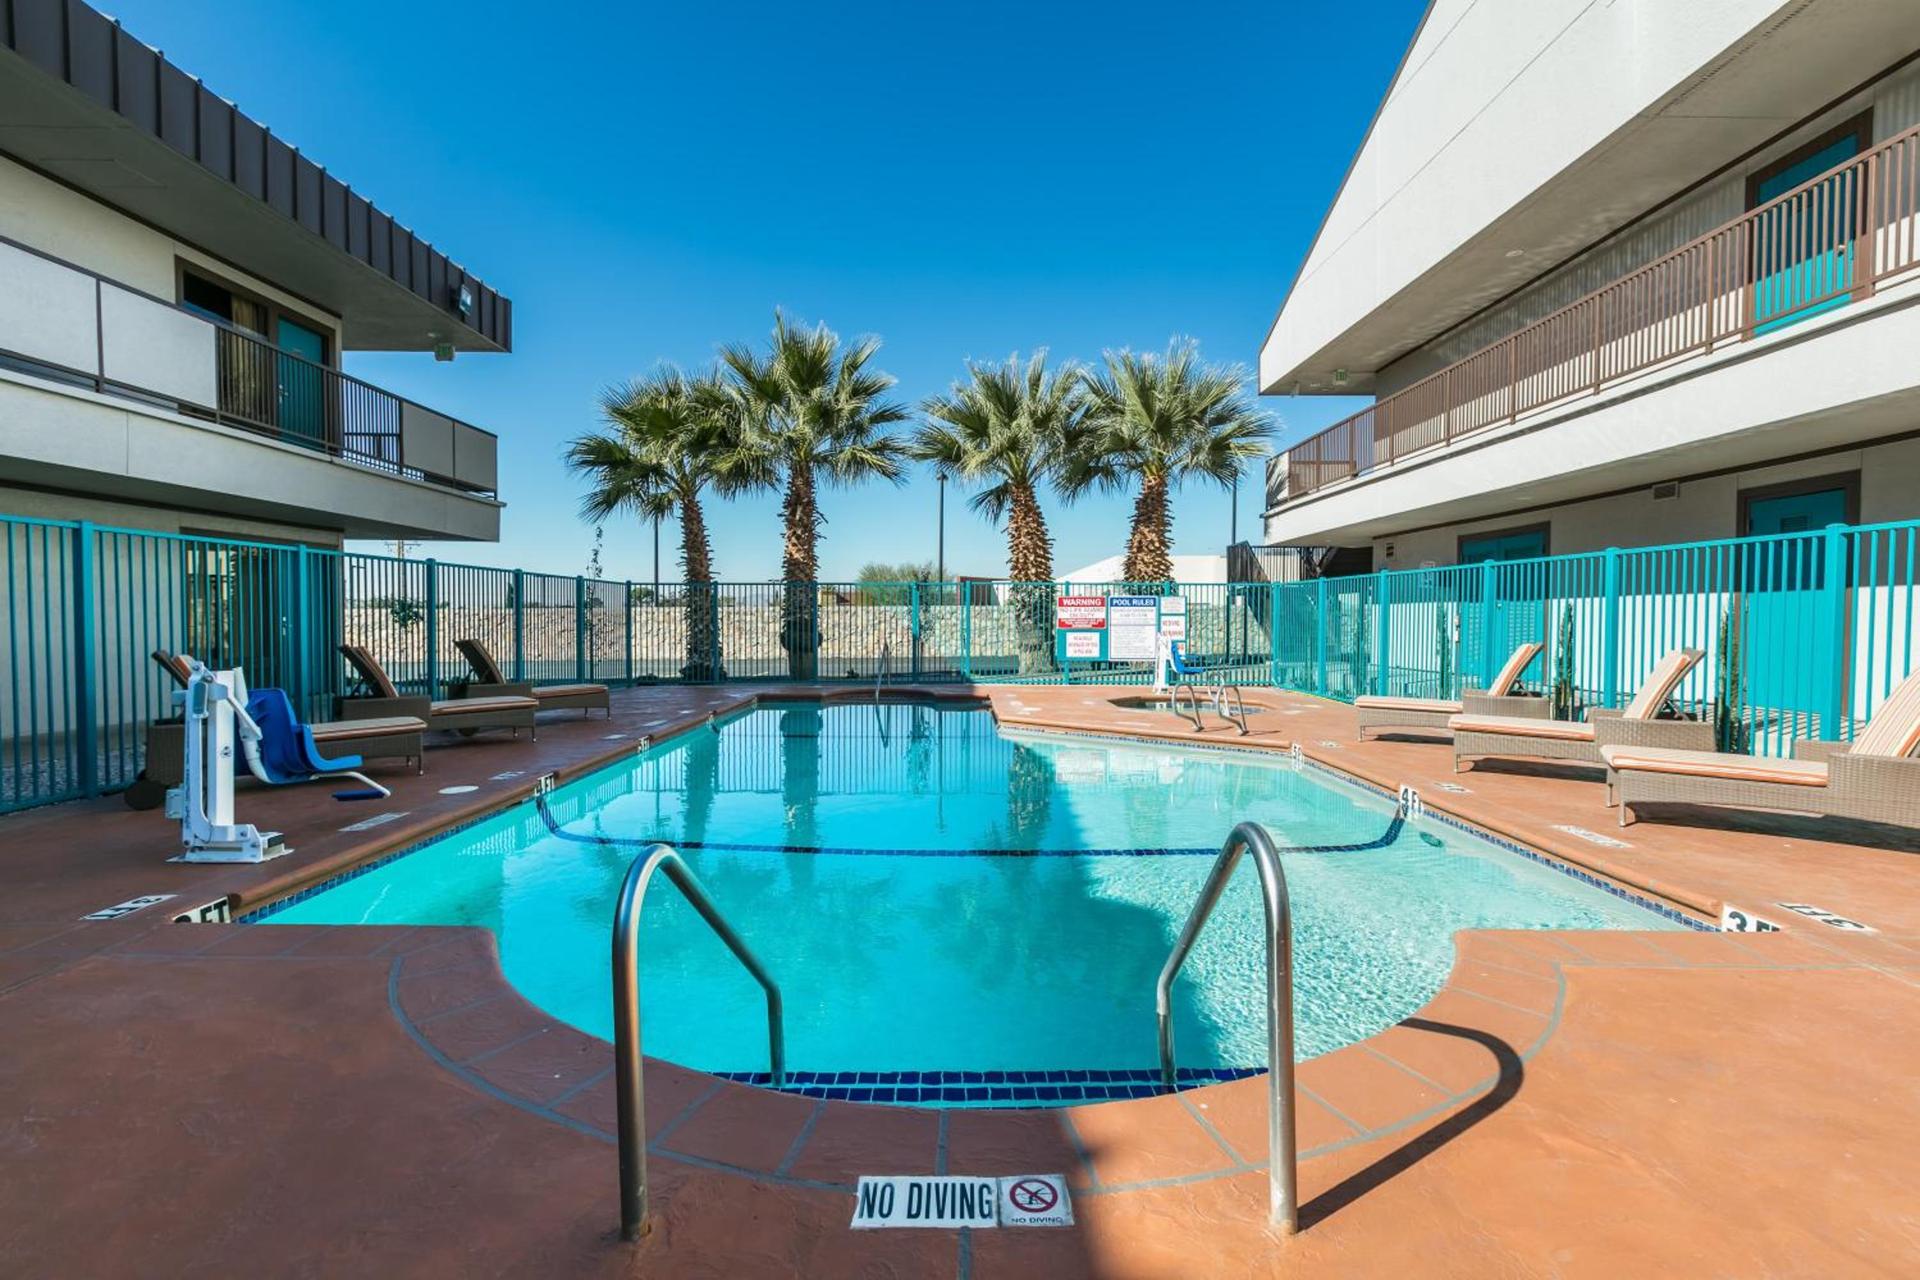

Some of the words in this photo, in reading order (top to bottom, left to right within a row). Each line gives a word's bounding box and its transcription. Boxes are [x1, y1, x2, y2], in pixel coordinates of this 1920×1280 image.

[1063, 598, 1101, 606] WARNING
[1112, 598, 1131, 606] POOL
[1132, 598, 1154, 606] RULES
[1402, 787, 1409, 804] 4
[1728, 911, 1748, 932] 3
[858, 1182, 895, 1219] NO
[906, 1182, 993, 1220] DIVING
